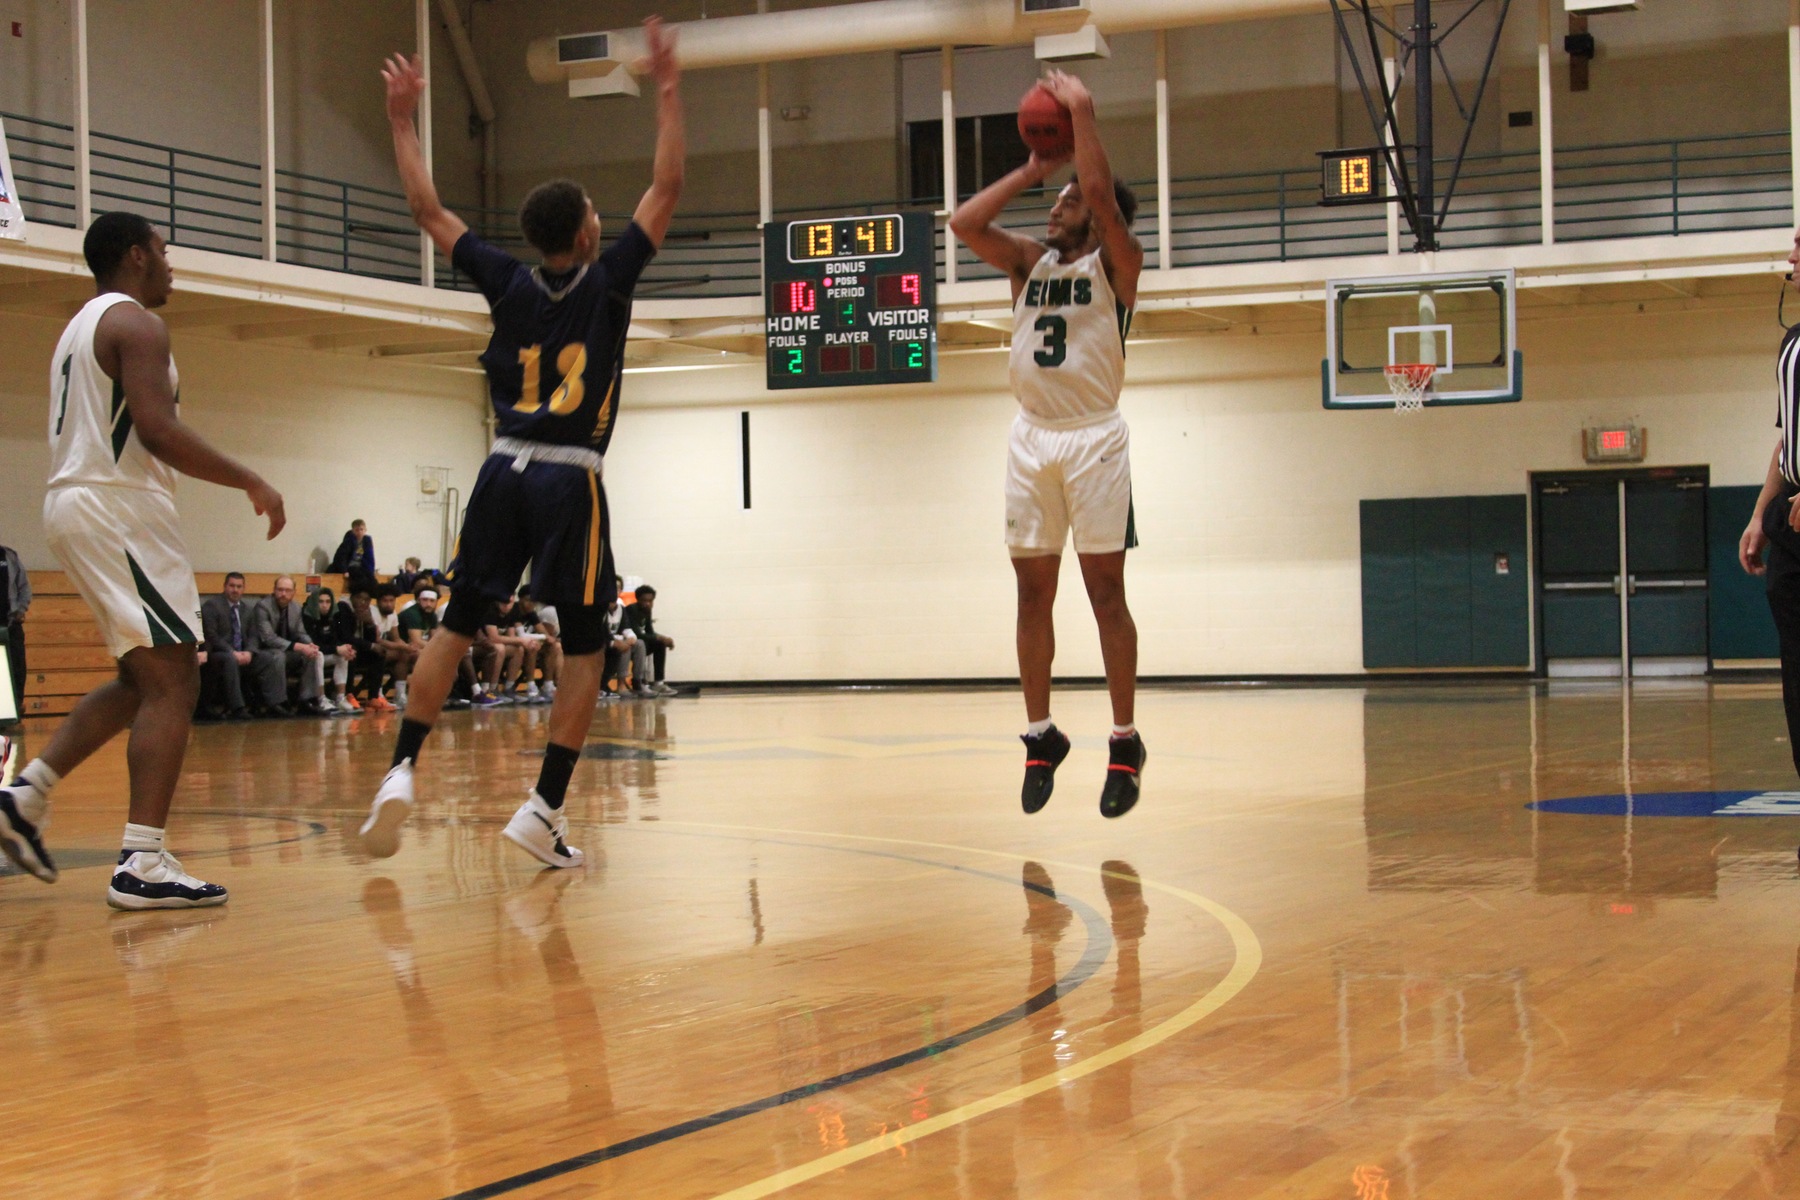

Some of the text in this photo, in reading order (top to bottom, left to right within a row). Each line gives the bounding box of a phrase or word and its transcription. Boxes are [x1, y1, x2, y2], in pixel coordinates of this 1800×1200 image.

[1340, 158, 1368, 194] 18
[825, 261, 866, 275] BONUS
[835, 276, 858, 286] POSS
[901, 274, 919, 305] 9
[790, 282, 815, 313] 10
[827, 287, 865, 299] PERIOD
[767, 315, 821, 332] HOME
[868, 309, 929, 327] VISITOR
[768, 335, 807, 348] FOULS
[825, 331, 869, 345] PLAYER
[888, 328, 928, 341] FOULS
[1034, 314, 1067, 368] 3
[788, 350, 802, 374] 2
[908, 343, 923, 368] 2
[56, 353, 73, 436] 1
